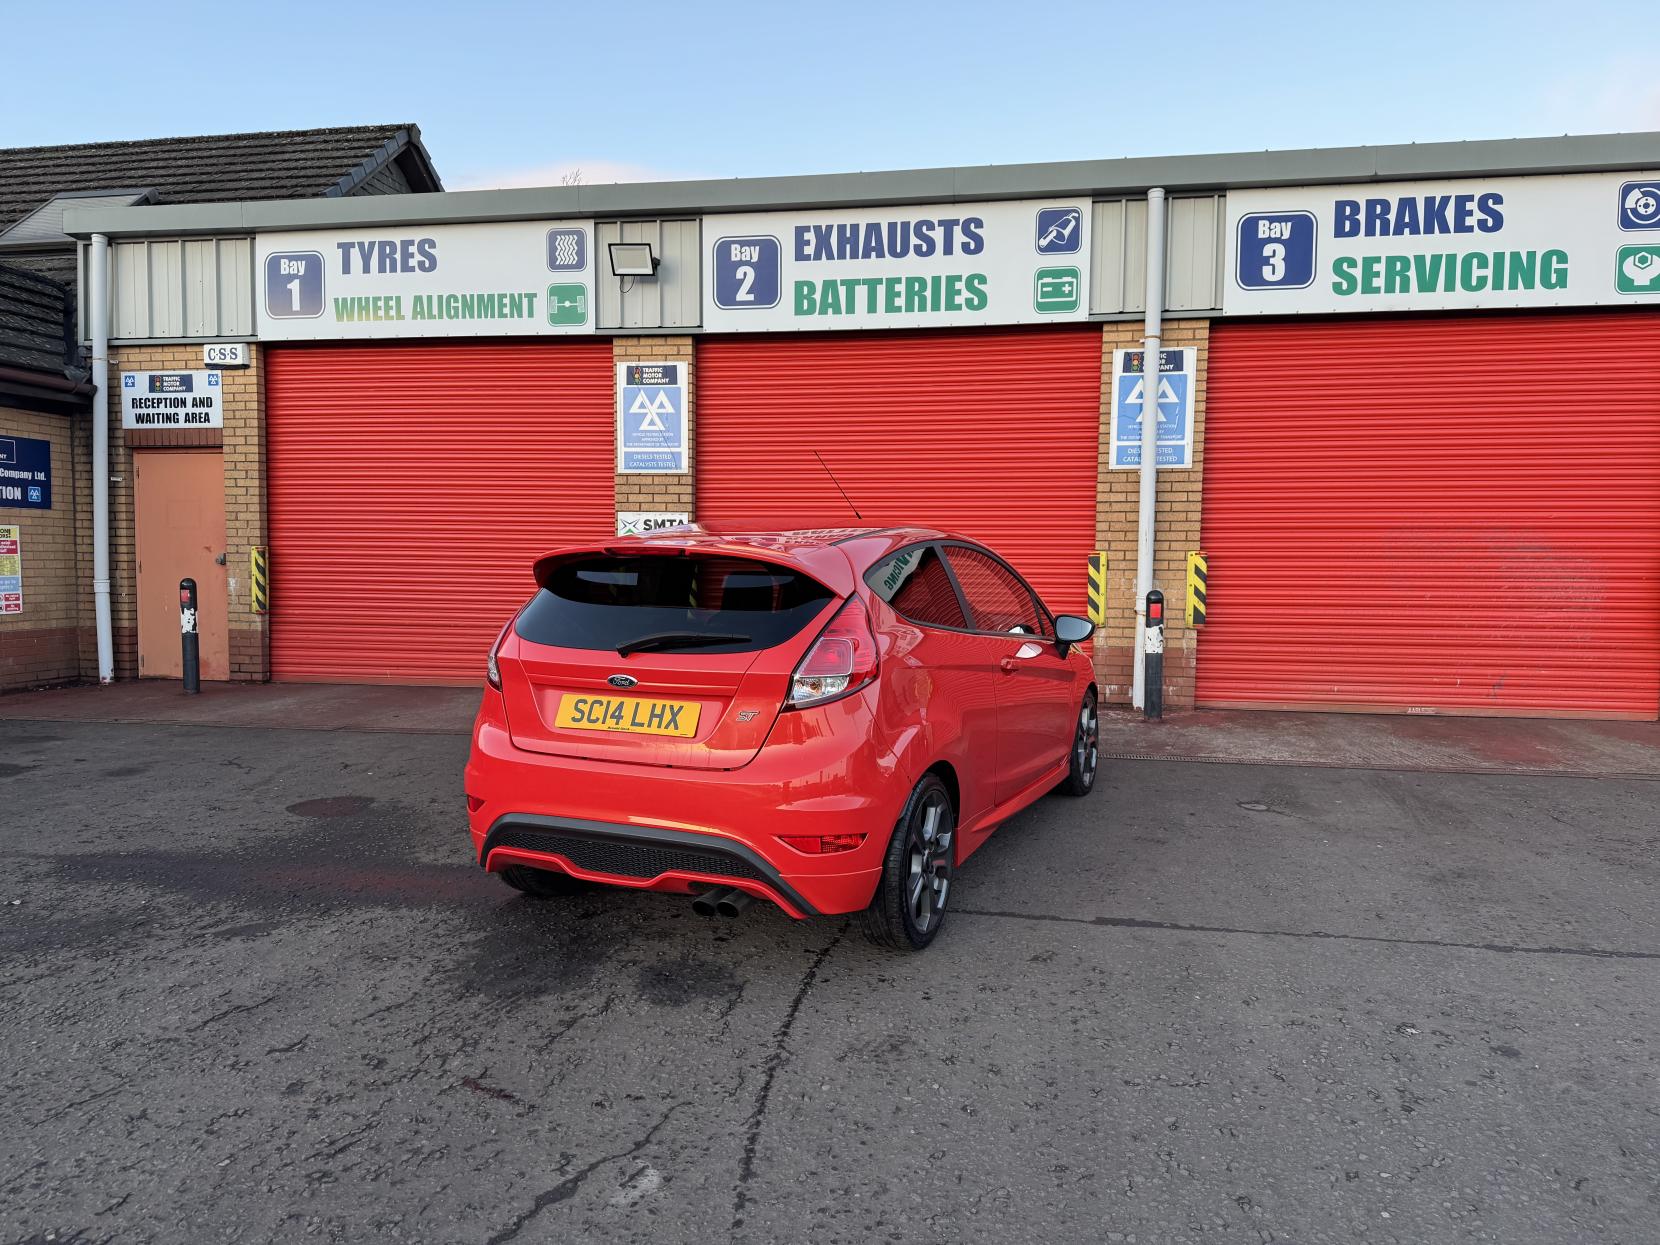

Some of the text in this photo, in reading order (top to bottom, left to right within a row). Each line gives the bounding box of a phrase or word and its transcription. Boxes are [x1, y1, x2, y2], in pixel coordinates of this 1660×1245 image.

[1258, 220, 1292, 240] Bay
[1334, 193, 1504, 239] BRAKES
[731, 244, 759, 262] Bay
[794, 217, 984, 262] EXHAUSTS
[280, 259, 306, 276] Bay
[336, 238, 437, 275] TYRES
[1262, 243, 1285, 282] 3
[735, 266, 755, 302] 2
[1332, 249, 1569, 296] SERVICING
[286, 279, 301, 312] 1
[334, 293, 538, 323] WHEEL ALIGNMENT
[794, 273, 988, 316] BATTERIES
[131, 396, 213, 409] RECEPTION AND
[135, 412, 211, 424] WAITING AREA
[0, 468, 47, 480] Company Ltd.
[612, 676, 631, 687] Ford
[571, 698, 684, 730] SC14 LHX
[736, 710, 759, 722] ST
